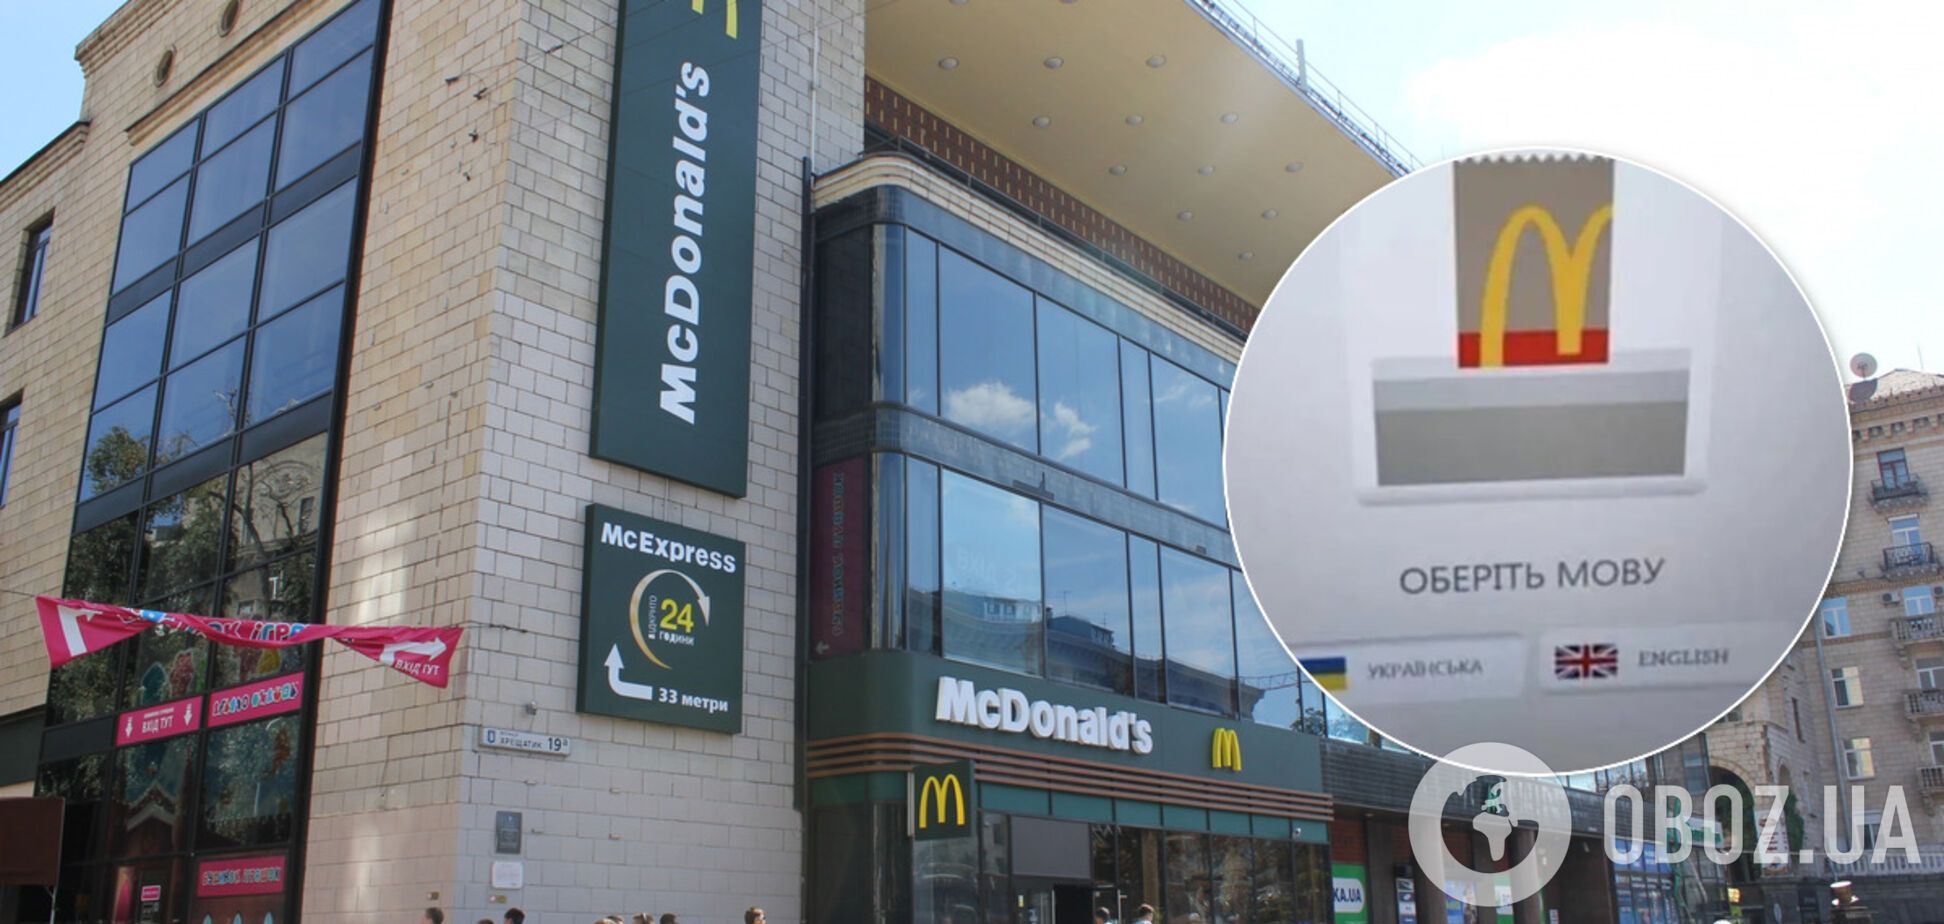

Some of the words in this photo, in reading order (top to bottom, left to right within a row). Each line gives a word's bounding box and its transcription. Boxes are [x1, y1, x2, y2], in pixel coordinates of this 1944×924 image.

[659, 60, 710, 424] McDonald's
[600, 521, 737, 573] McExpress
[1399, 563, 1545, 595] ОБЕРІТЬ
[1557, 558, 1666, 589] МОВУ
[660, 598, 694, 633] 24
[395, 659, 421, 676] ВХІД
[1367, 659, 1484, 680] УКРАЇНСЬКА
[1638, 649, 1729, 668] ENGLISH
[659, 687, 678, 704] 33
[682, 694, 729, 714] метри
[935, 675, 1153, 754] McDonald's
[142, 718, 159, 734] ВХІД
[160, 714, 174, 729] ТУТ
